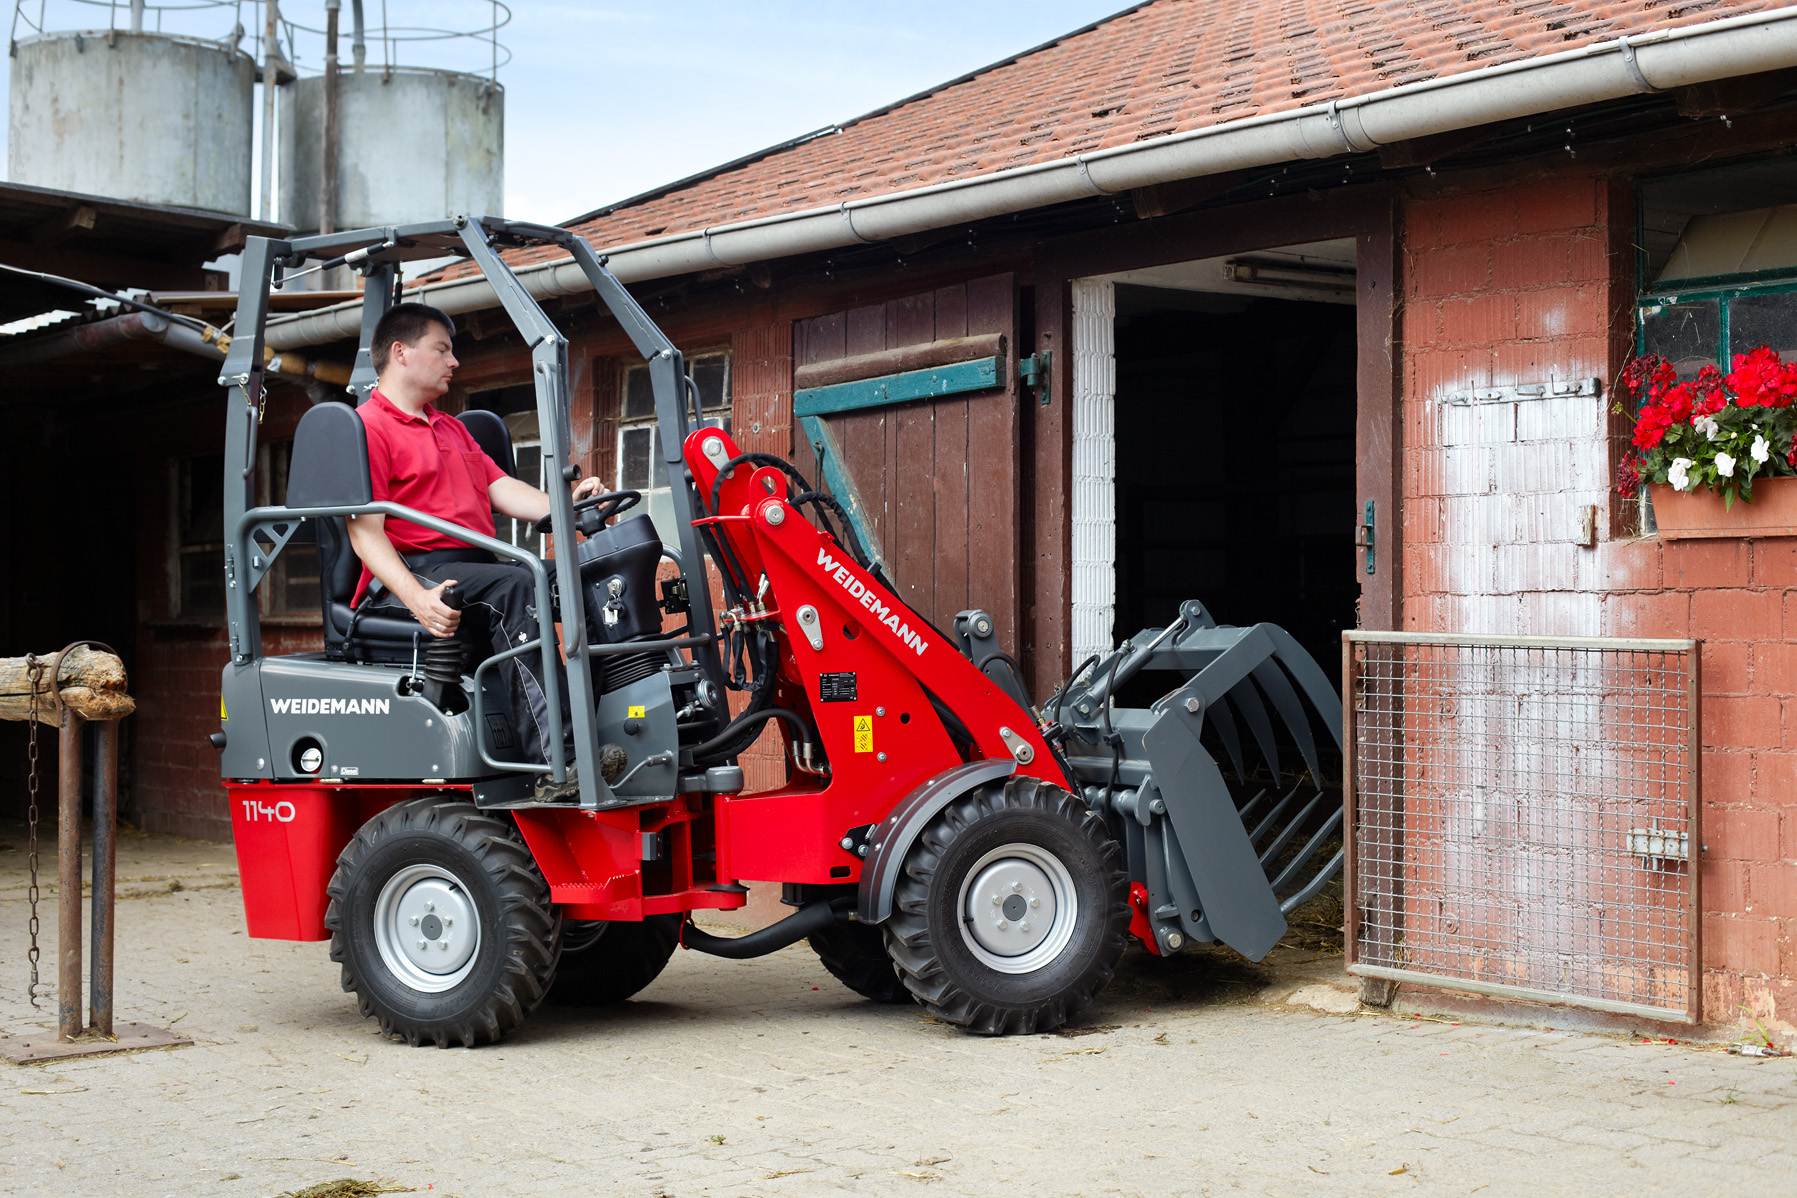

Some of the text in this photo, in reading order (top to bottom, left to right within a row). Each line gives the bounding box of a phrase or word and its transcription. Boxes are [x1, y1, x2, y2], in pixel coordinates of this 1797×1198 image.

[817, 547, 929, 656] WEIDEMANN
[270, 698, 390, 714] WEIDEMANN
[242, 800, 296, 822] 1140
